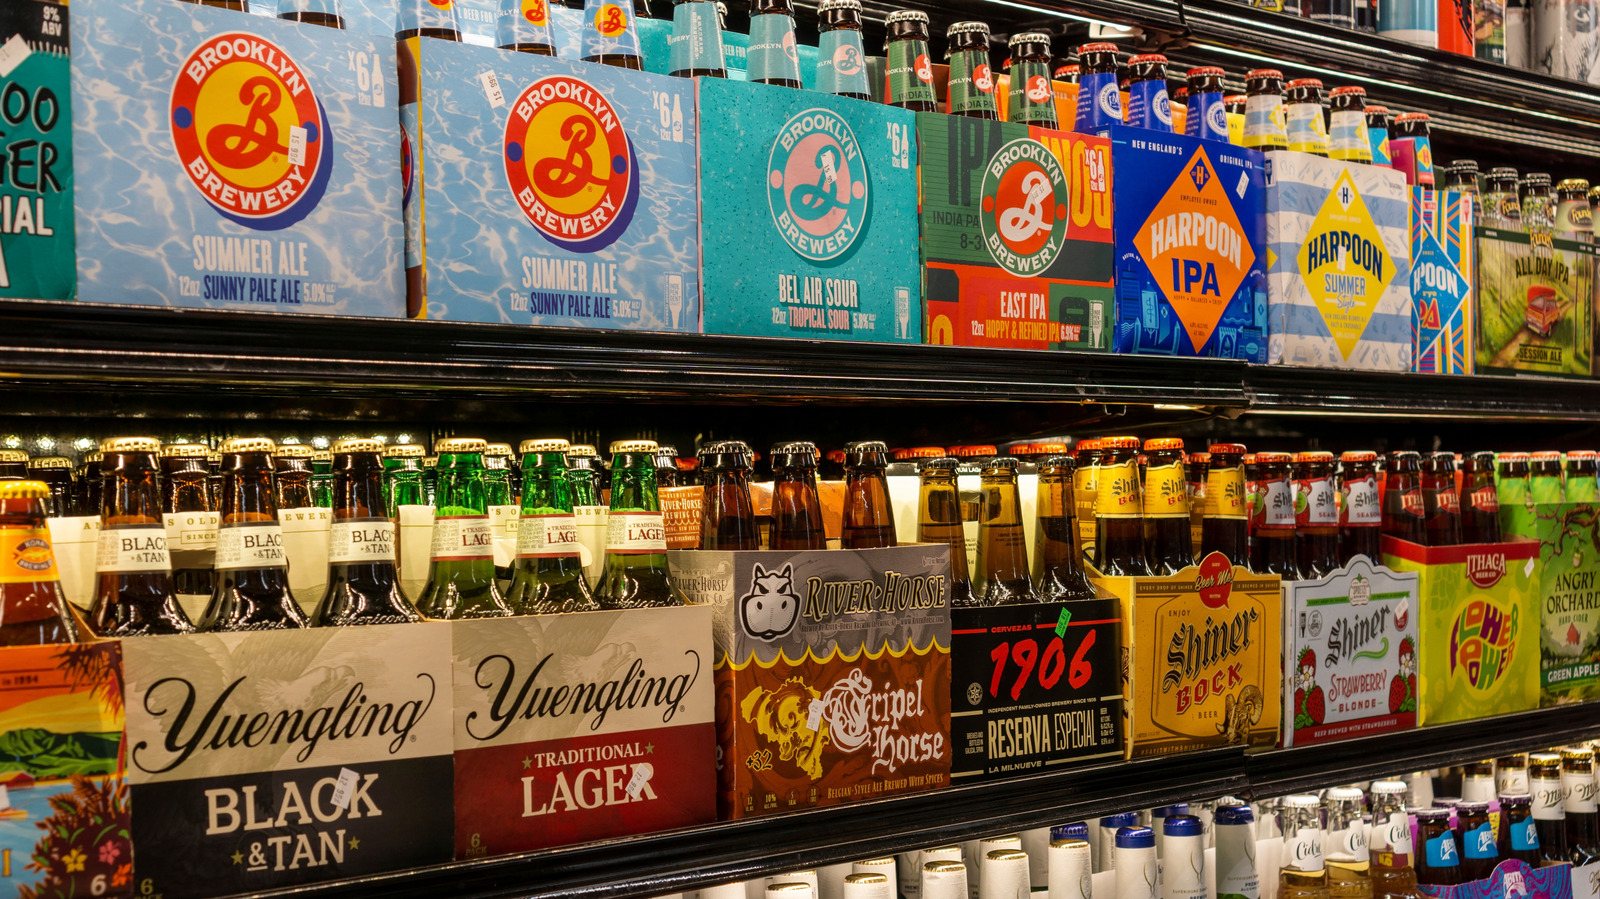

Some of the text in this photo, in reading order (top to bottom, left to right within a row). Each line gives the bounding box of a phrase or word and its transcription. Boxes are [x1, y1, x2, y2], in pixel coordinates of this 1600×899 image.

[43, 6, 60, 21] 9%
[41, 21, 62, 36] ABV
[186, 38, 307, 98] BROOKLYN
[516, 81, 617, 134] BROOKLYN
[780, 114, 857, 162] BROOKLYN
[1132, 140, 1183, 155] NEW ENGLAND'S
[991, 144, 1063, 186] BROOKLYN
[1220, 155, 1244, 167] ORIGINAL
[187, 155, 307, 212] BREWERY
[518, 186, 616, 235] BREWERY
[933, 211, 962, 227] INDIA
[778, 210, 855, 255] BREWERY
[1150, 212, 1242, 272] HARPOON
[192, 234, 309, 277] SUMMER ALE
[988, 232, 1058, 272] BREWERY
[1308, 230, 1382, 284] HARPOON
[522, 256, 618, 295] SUMMER ALE
[1171, 257, 1221, 297] IPA
[1324, 273, 1366, 296] SUMMER
[1515, 257, 1569, 285] ALL DAY IPA
[203, 274, 246, 302] SUNNY
[249, 276, 277, 303] PALE
[280, 279, 301, 304] ALE
[303, 282, 326, 304] 5.0%
[778, 274, 858, 308] BEL AIR SOUR
[530, 291, 566, 315] SUNNY
[568, 294, 591, 318] PALE
[593, 297, 611, 319] ALE
[613, 299, 632, 319] 5.0%
[788, 307, 826, 329] TROPICAL
[828, 309, 849, 330] SOUR
[1000, 291, 1046, 320] EAST IPA
[986, 320, 1010, 339] HOPPY
[1011, 321, 1017, 339] &
[1019, 322, 1048, 341] REFINED
[1049, 323, 1060, 341] IPA
[1519, 347, 1562, 362] SESSION ALE
[244, 534, 282, 549] BLAC
[1195, 567, 1237, 591] Beer Me!
[1466, 553, 1506, 578] ITHACA
[1555, 571, 1597, 593] ANGRY
[1169, 609, 1191, 617] ENJOY
[1559, 612, 1588, 626] HARD CIDER
[991, 624, 1032, 634] CERVEZAS
[1325, 604, 1391, 668] Shiner
[1450, 600, 1519, 679] FLOWER
[1162, 606, 1259, 693] Shiner
[990, 629, 1096, 701] 1906
[1460, 638, 1516, 690] POWER
[1548, 662, 1600, 683] GREEN APPLE
[466, 649, 701, 741] Yuengling
[1176, 661, 1243, 715] BOCK
[1328, 669, 1388, 702] STRAWBERRY
[988, 705, 1018, 714] INDEPENDENT
[1018, 702, 1052, 710] FAMILY-OWNED
[1198, 710, 1218, 719] BEER
[1338, 698, 1377, 713] BLONDE
[132, 672, 436, 774] Yuengling
[988, 714, 1051, 760] RESERVA
[1054, 709, 1098, 751] ESPECIAL
[1314, 730, 1325, 738] BEER
[1362, 719, 1397, 730] STRAWBERRIES
[534, 742, 644, 769] TRADITIONAL
[746, 750, 773, 772] +32
[988, 760, 1042, 774] LA MILNUEVE
[521, 761, 658, 818] LAGER
[872, 780, 882, 792] ALE
[884, 778, 907, 790] BREWED
[909, 776, 924, 788] WITH
[925, 773, 943, 785] SPICES
[204, 773, 383, 836] BLACK
[765, 794, 777, 803] 10%
[471, 832, 480, 847] 6
[90, 874, 106, 896] 6
[141, 878, 154, 895] 6
